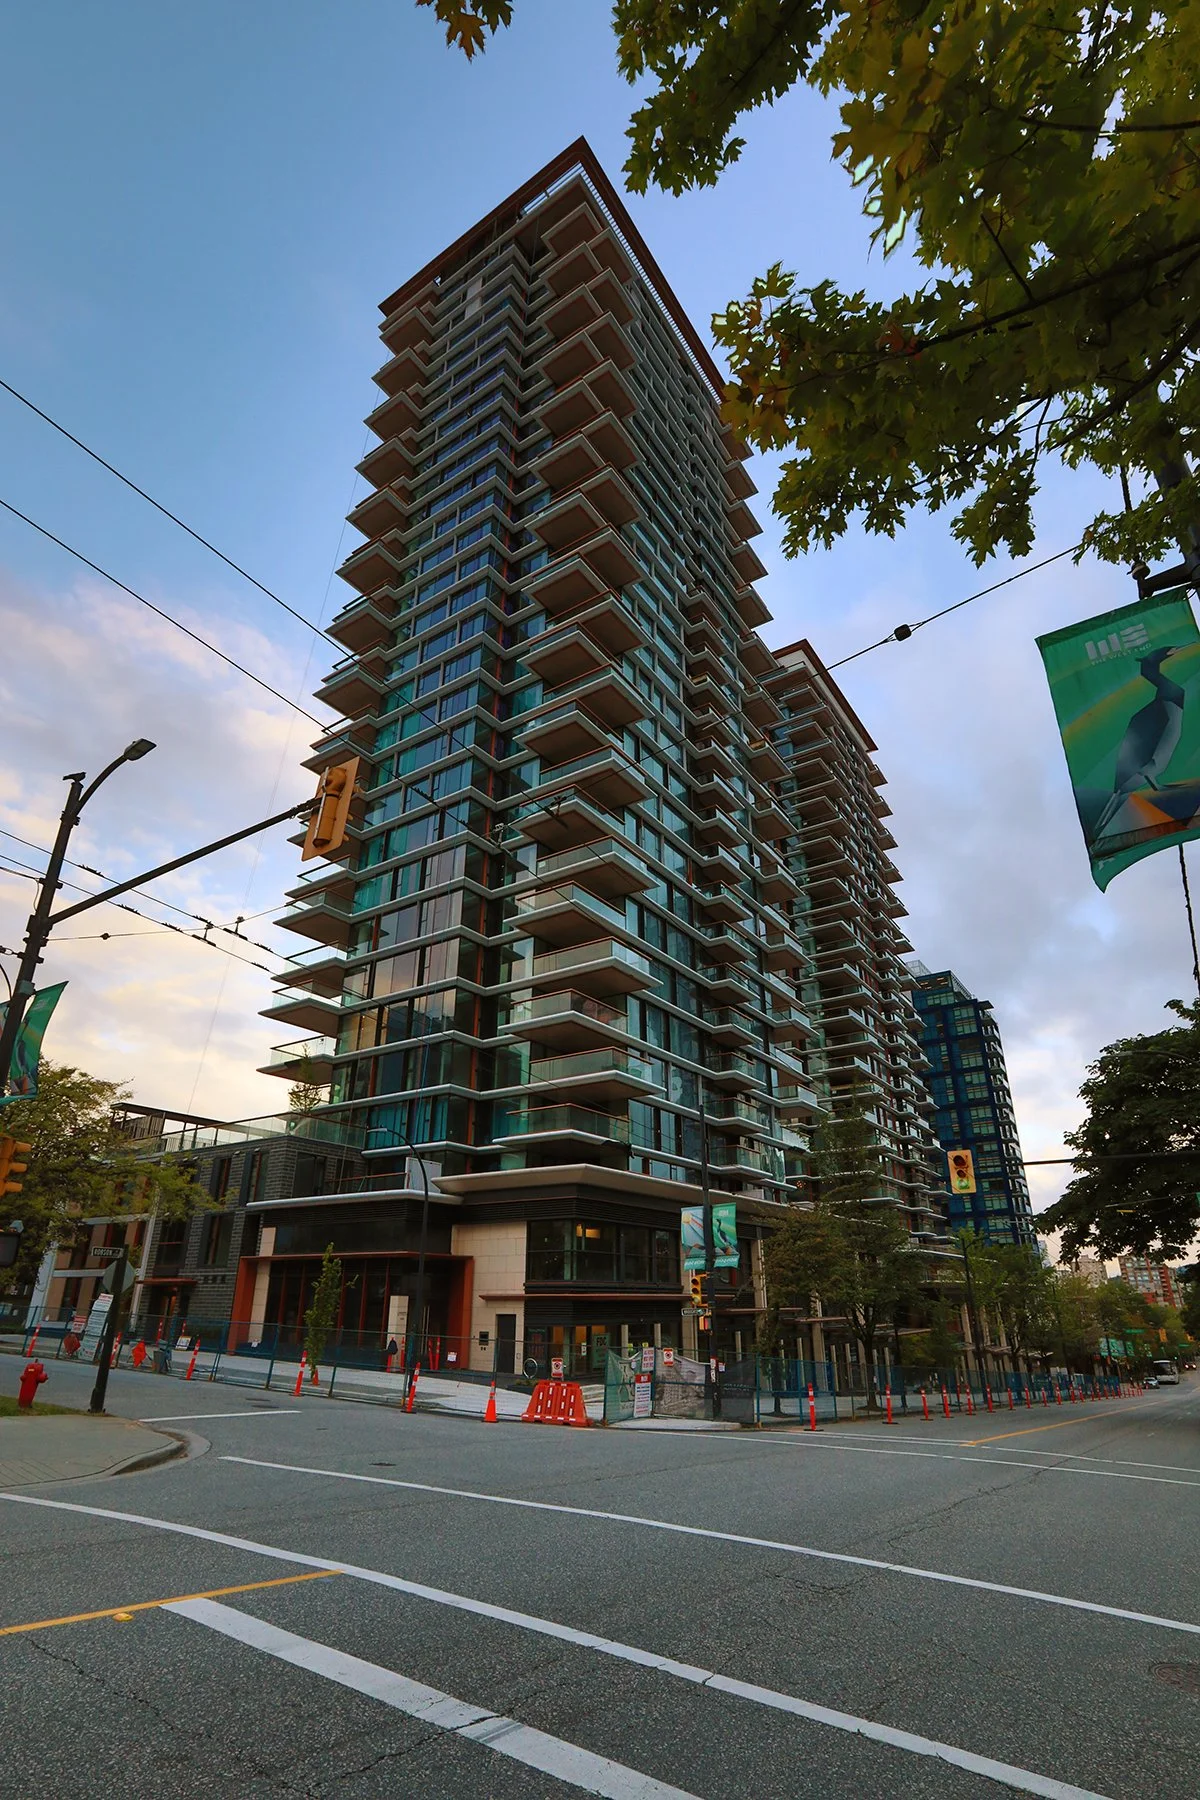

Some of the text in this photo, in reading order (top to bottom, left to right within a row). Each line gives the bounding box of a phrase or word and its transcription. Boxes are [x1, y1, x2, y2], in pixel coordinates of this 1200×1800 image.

[1091, 658, 1107, 666] THE
[1109, 651, 1132, 660] WEST
[94, 1248, 113, 1256] ROBSON
